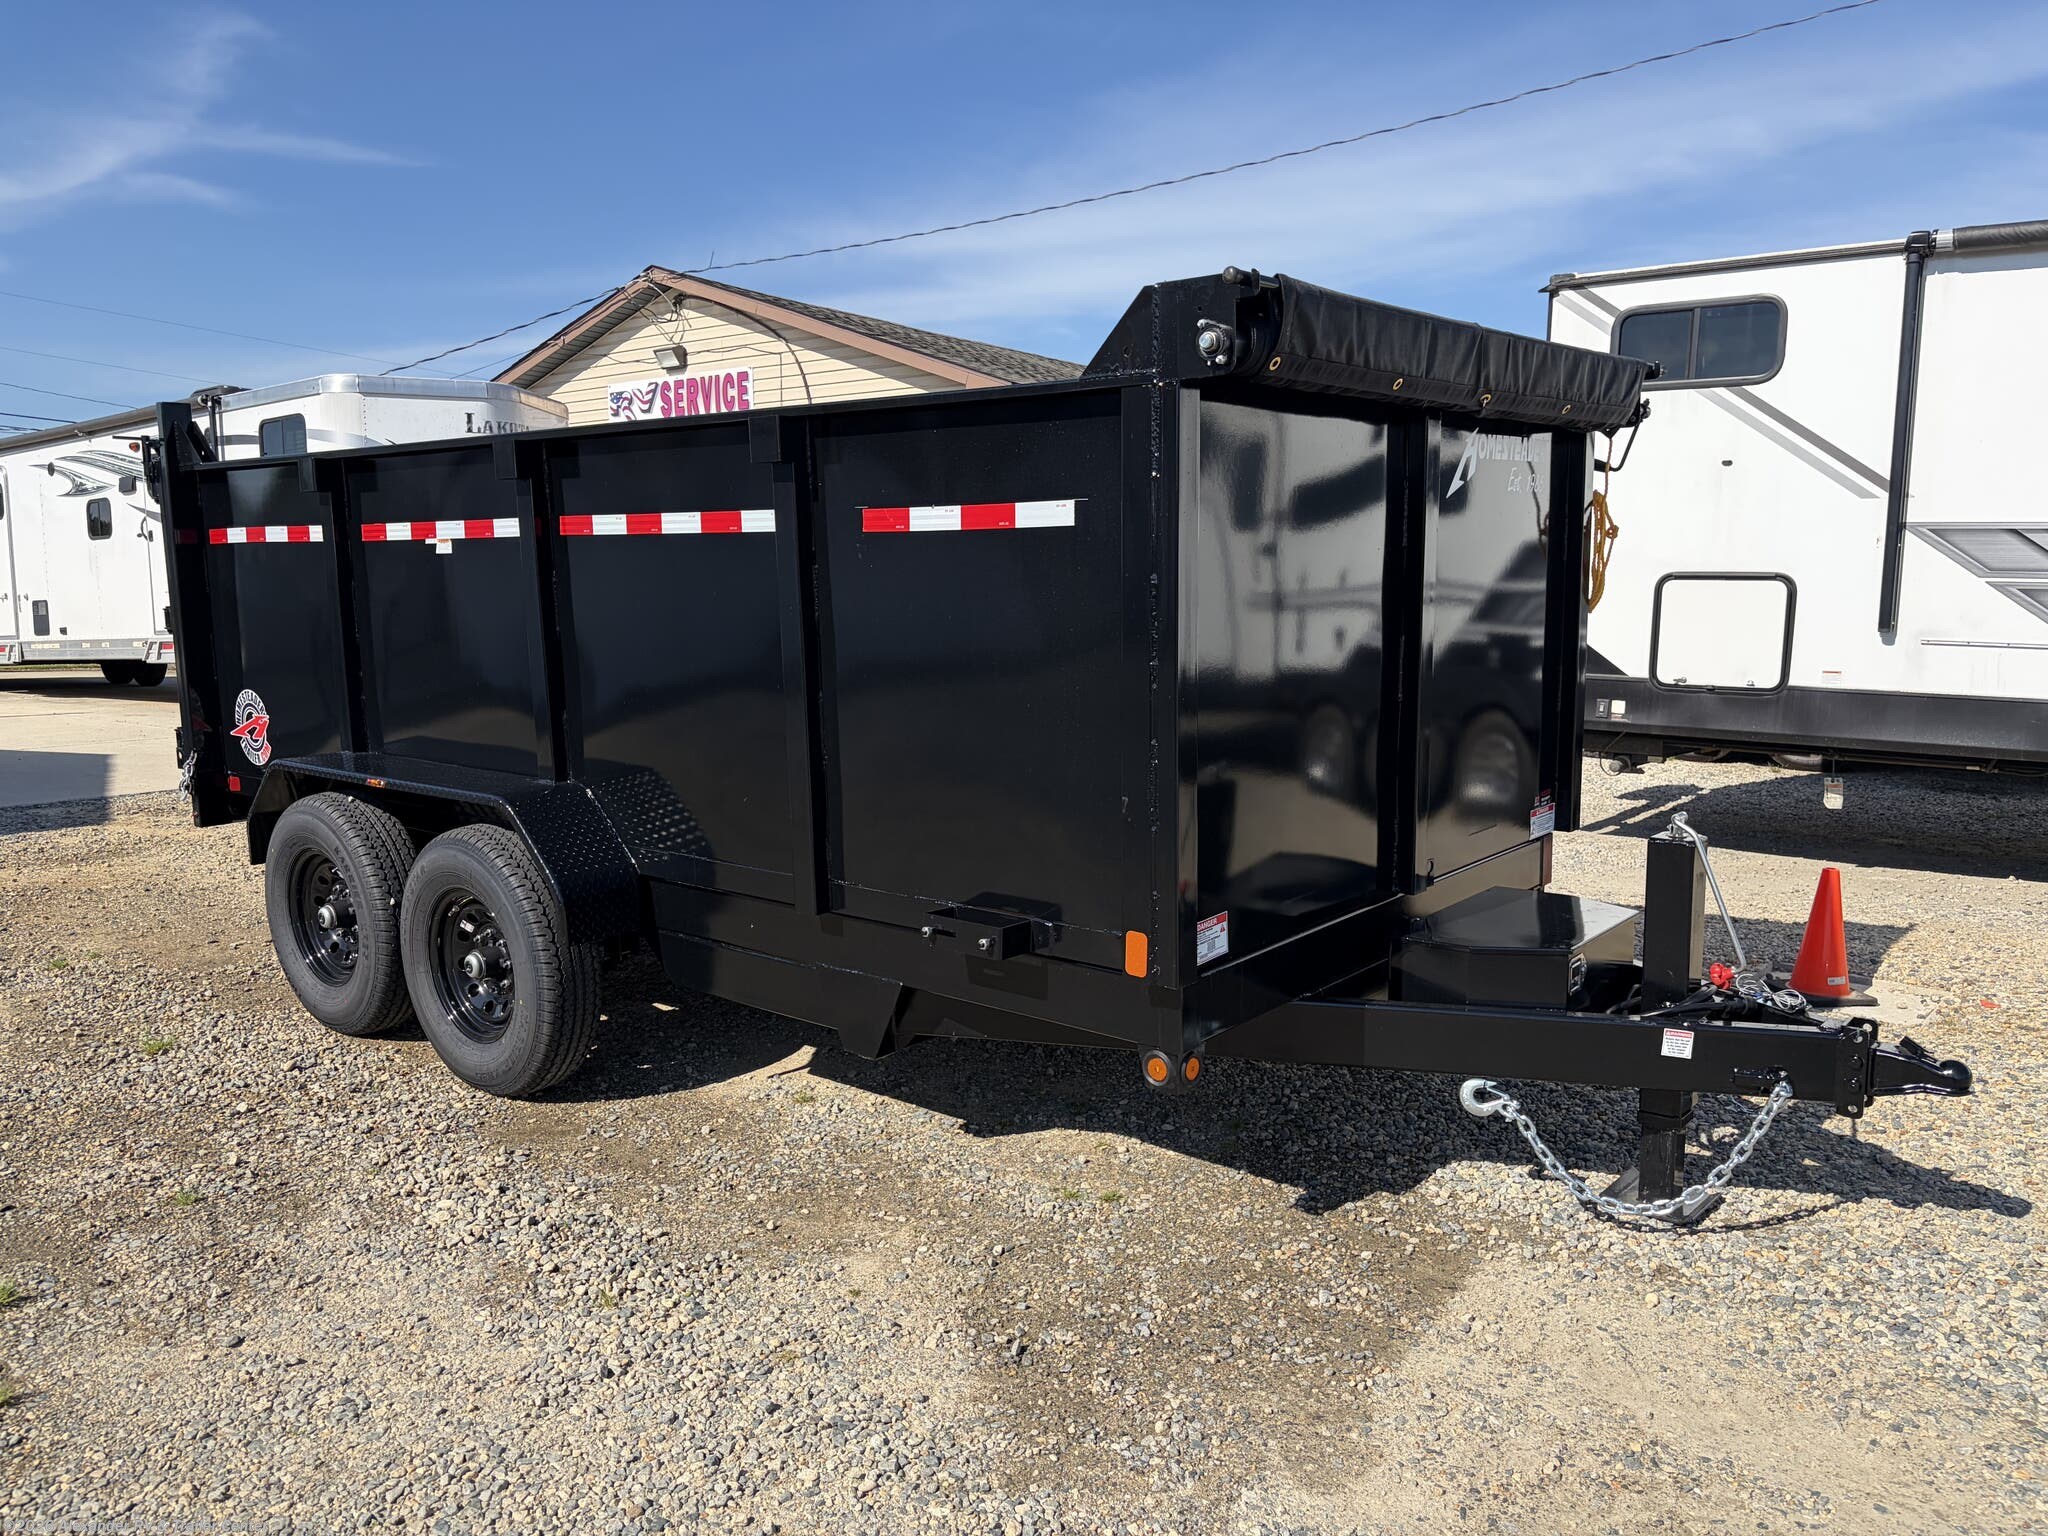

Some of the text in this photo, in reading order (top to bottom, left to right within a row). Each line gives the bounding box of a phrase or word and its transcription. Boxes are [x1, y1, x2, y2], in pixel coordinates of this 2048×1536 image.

[609, 371, 750, 421] RV SERVICE
[1197, 917, 1218, 930] DANGER
